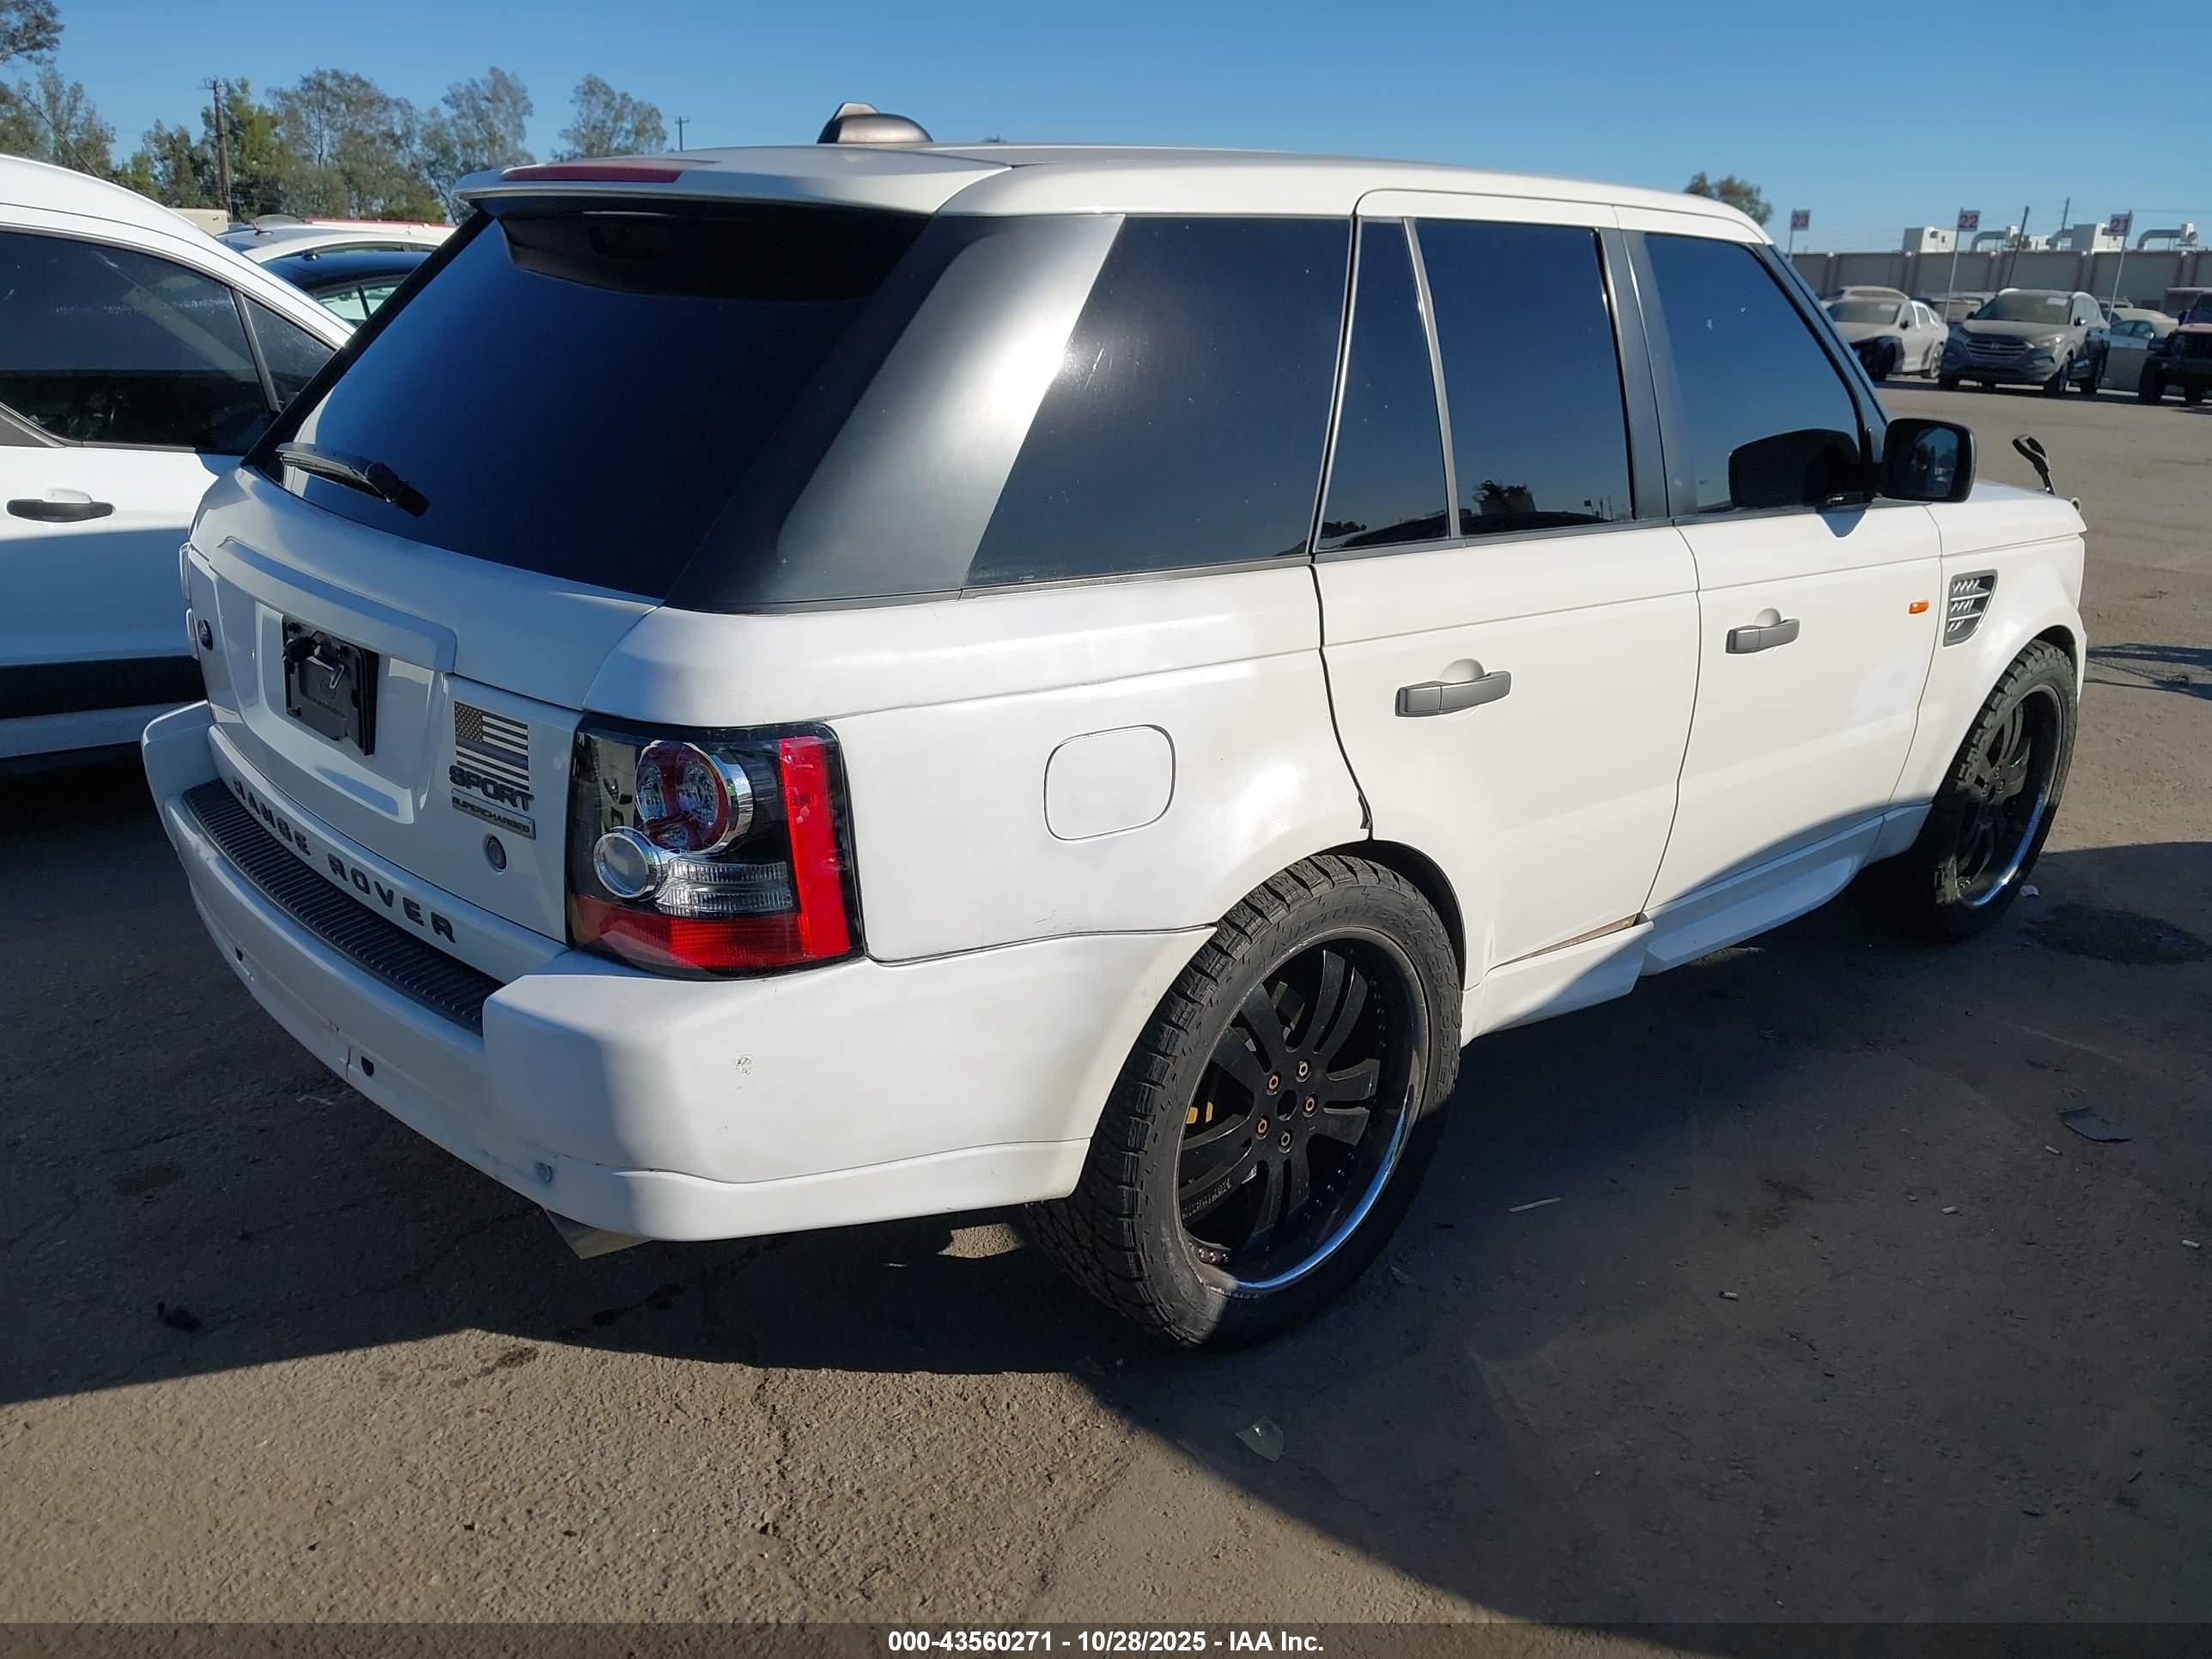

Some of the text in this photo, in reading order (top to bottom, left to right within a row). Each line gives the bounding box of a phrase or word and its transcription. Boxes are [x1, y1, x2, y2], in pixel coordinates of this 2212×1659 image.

[1958, 214, 1978, 228] 22
[2110, 218, 2130, 234] 21
[449, 764, 534, 811] SPORT
[452, 795, 531, 833] SUPERCHARGED
[233, 775, 456, 944] RANGE ROVER
